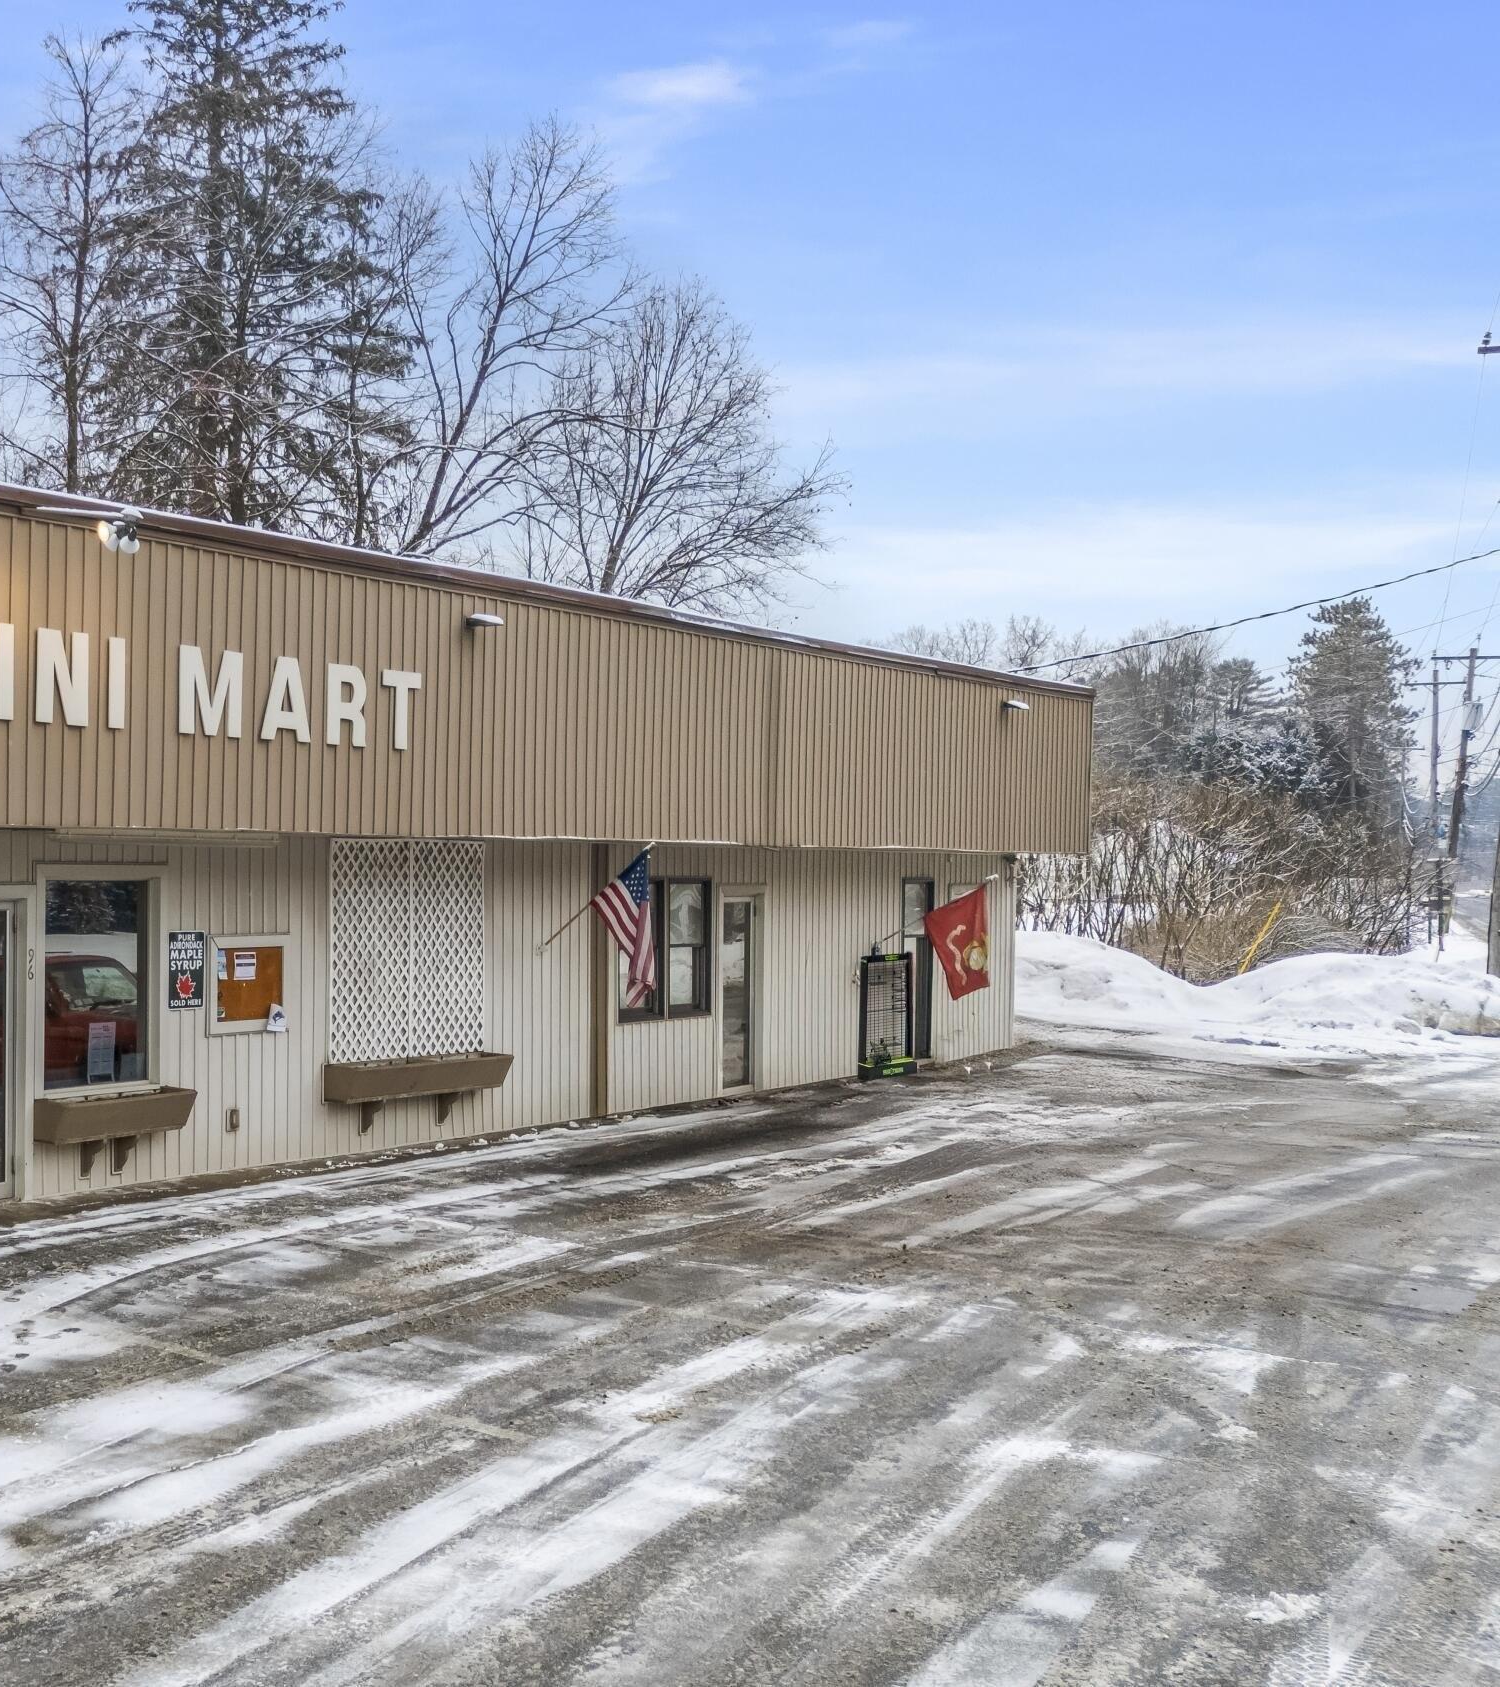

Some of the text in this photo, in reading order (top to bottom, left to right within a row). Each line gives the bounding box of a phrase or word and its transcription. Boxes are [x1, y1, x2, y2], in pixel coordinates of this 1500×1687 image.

[178, 644, 422, 750] MART
[170, 941, 203, 950] ADIRONDACK
[170, 950, 203, 960] MAPLE
[27, 948, 35, 980] 96
[170, 960, 203, 971] SYRUP
